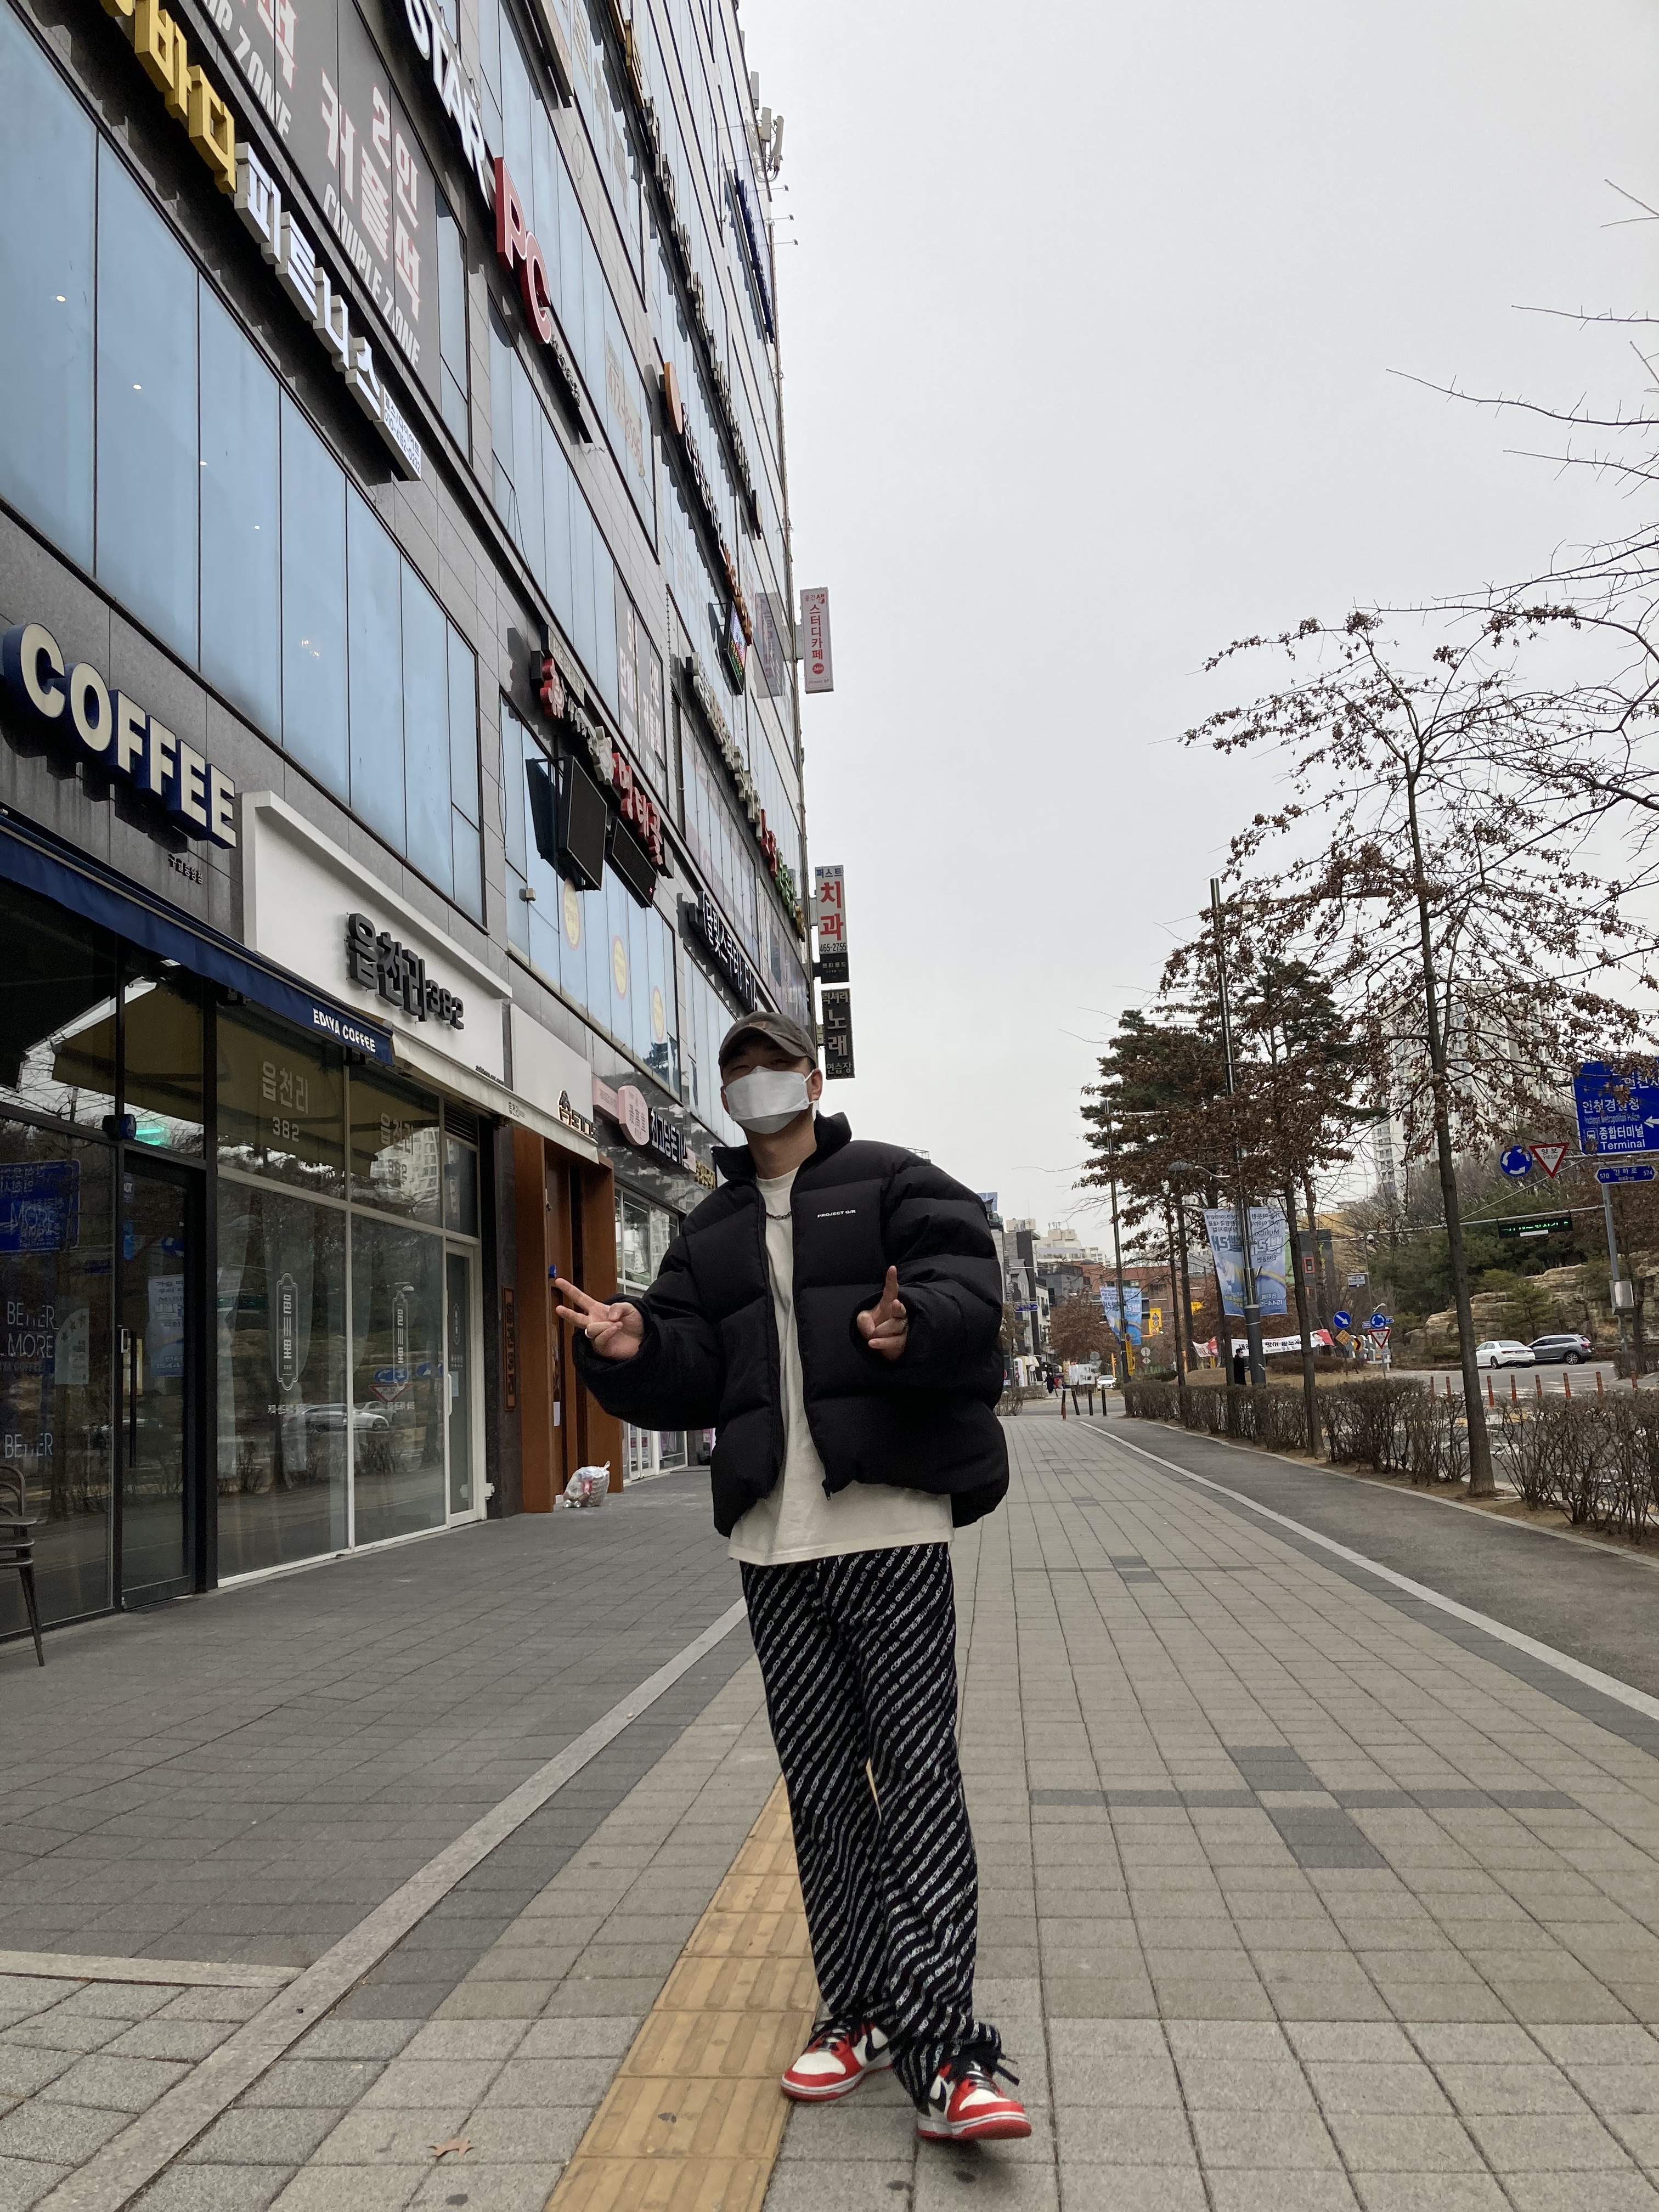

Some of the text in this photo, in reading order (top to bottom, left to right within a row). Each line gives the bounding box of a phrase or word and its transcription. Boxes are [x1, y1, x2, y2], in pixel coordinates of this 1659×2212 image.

[101, 0, 381, 421] 바디 피트니스
[322, 68, 421, 320] 커플석
[495, 157, 552, 345] PC
[383, 287, 421, 371] ZONE
[385, 409, 420, 474] 010-4152-0232
[809, 605, 823, 660] 스터디카페
[19, 623, 236, 848] COFFEE
[816, 868, 843, 878] 퍼스트
[820, 881, 844, 941] 치과
[348, 913, 464, 1029] 읍천리 382
[820, 943, 847, 952] 465-2755
[823, 991, 849, 1005] 럭셔리
[313, 1008, 376, 1053] EDIYA COFFEE
[827, 1009, 849, 1057] 노래
[262, 1060, 309, 1114] 읍천리
[827, 1063, 851, 1075] 연습장
[272, 1116, 300, 1142] 382
[380, 1113, 414, 1154] 읍천리
[1599, 1124, 1645, 1140] 종합터미널
[1600, 1139, 1645, 1150] Terminal
[8, 1333, 53, 1358] MORE
